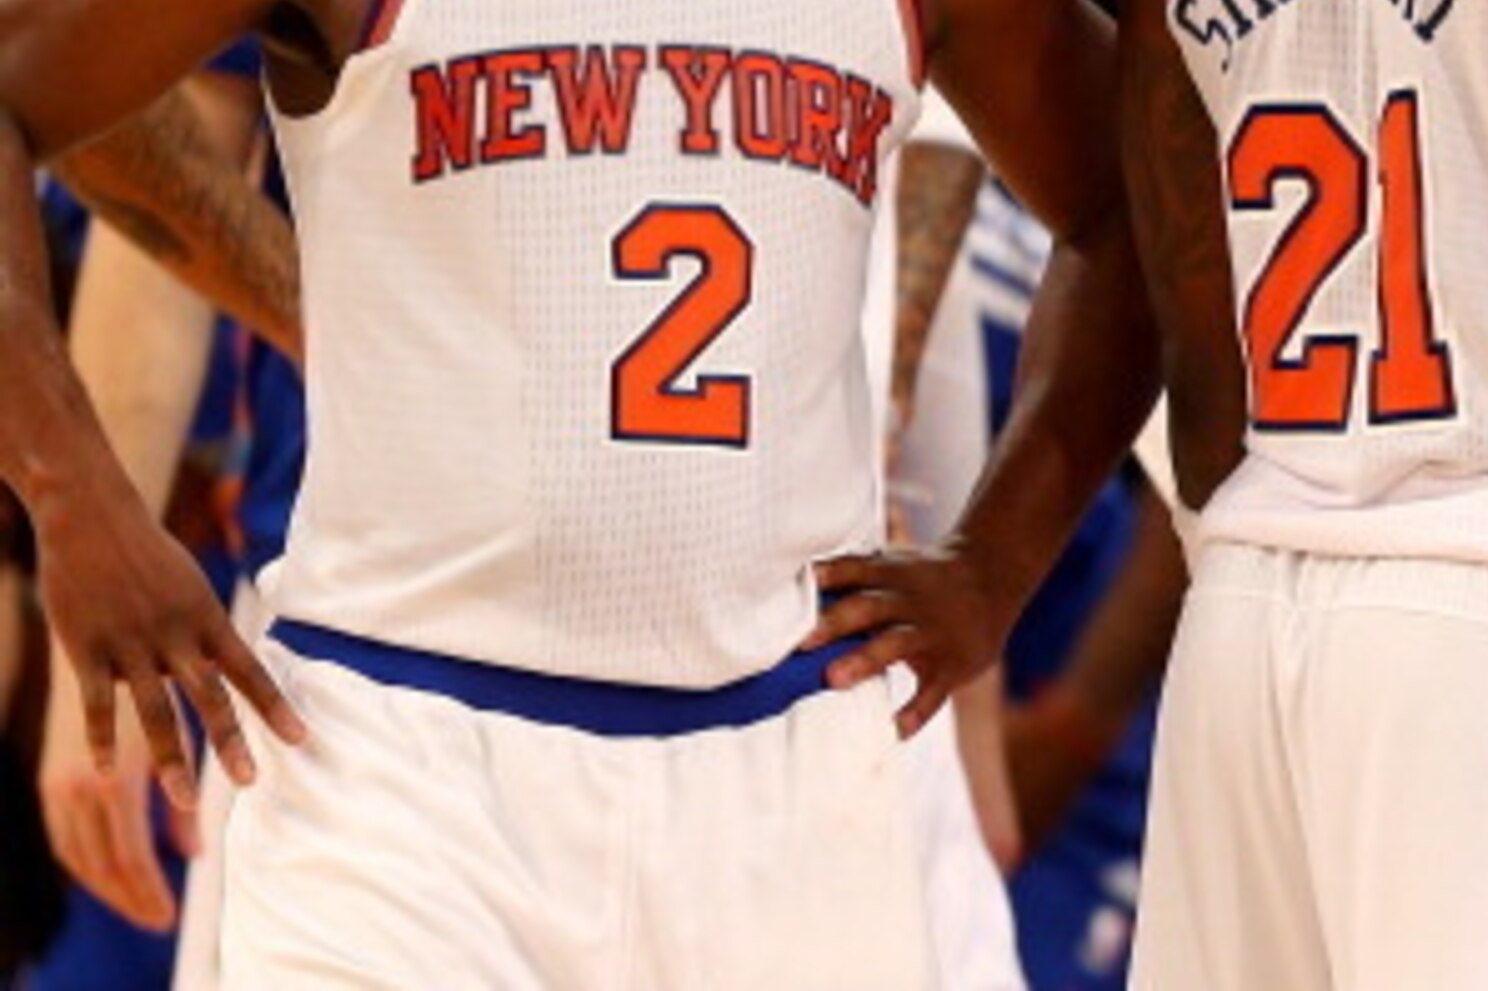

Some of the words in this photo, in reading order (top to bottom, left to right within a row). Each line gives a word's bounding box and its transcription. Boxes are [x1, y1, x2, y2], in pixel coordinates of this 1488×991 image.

[409, 44, 647, 184] NEW
[658, 43, 893, 208] YORK
[610, 202, 754, 448] 2
[1228, 88, 1457, 433] 21
